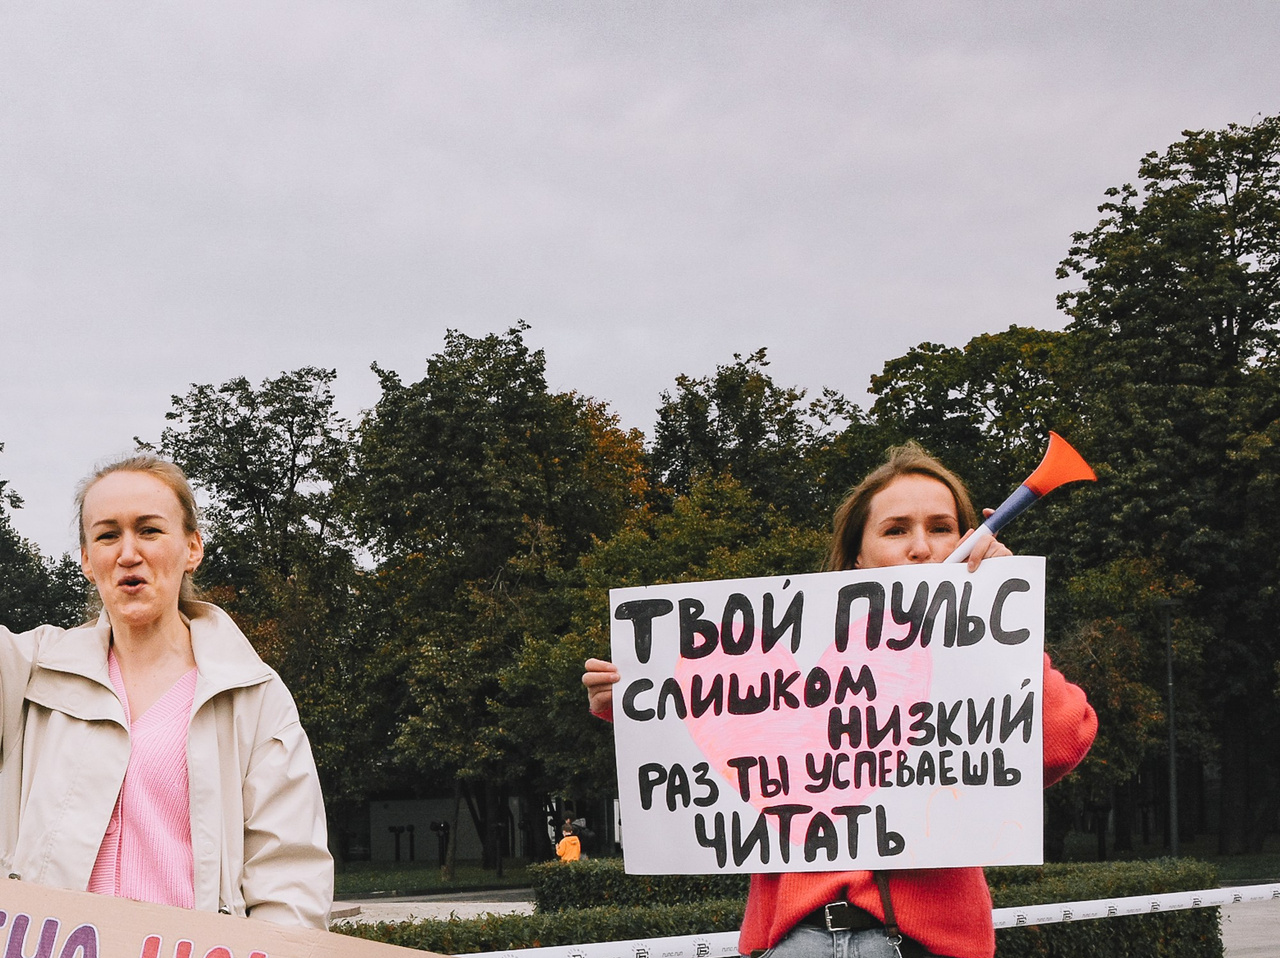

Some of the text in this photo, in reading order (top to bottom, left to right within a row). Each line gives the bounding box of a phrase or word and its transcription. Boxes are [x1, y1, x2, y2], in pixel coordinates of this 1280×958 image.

[615, 578, 1031, 664] ТВОЙ ПУЛЬС
[622, 664, 877, 721] СЛИШКОМ
[828, 678, 1035, 750] НИЗКИЙ
[638, 748, 1021, 811] РАЗ ТЫ УСПЕВАЕШЬ
[695, 804, 906, 868] ЧИТАТЬ
